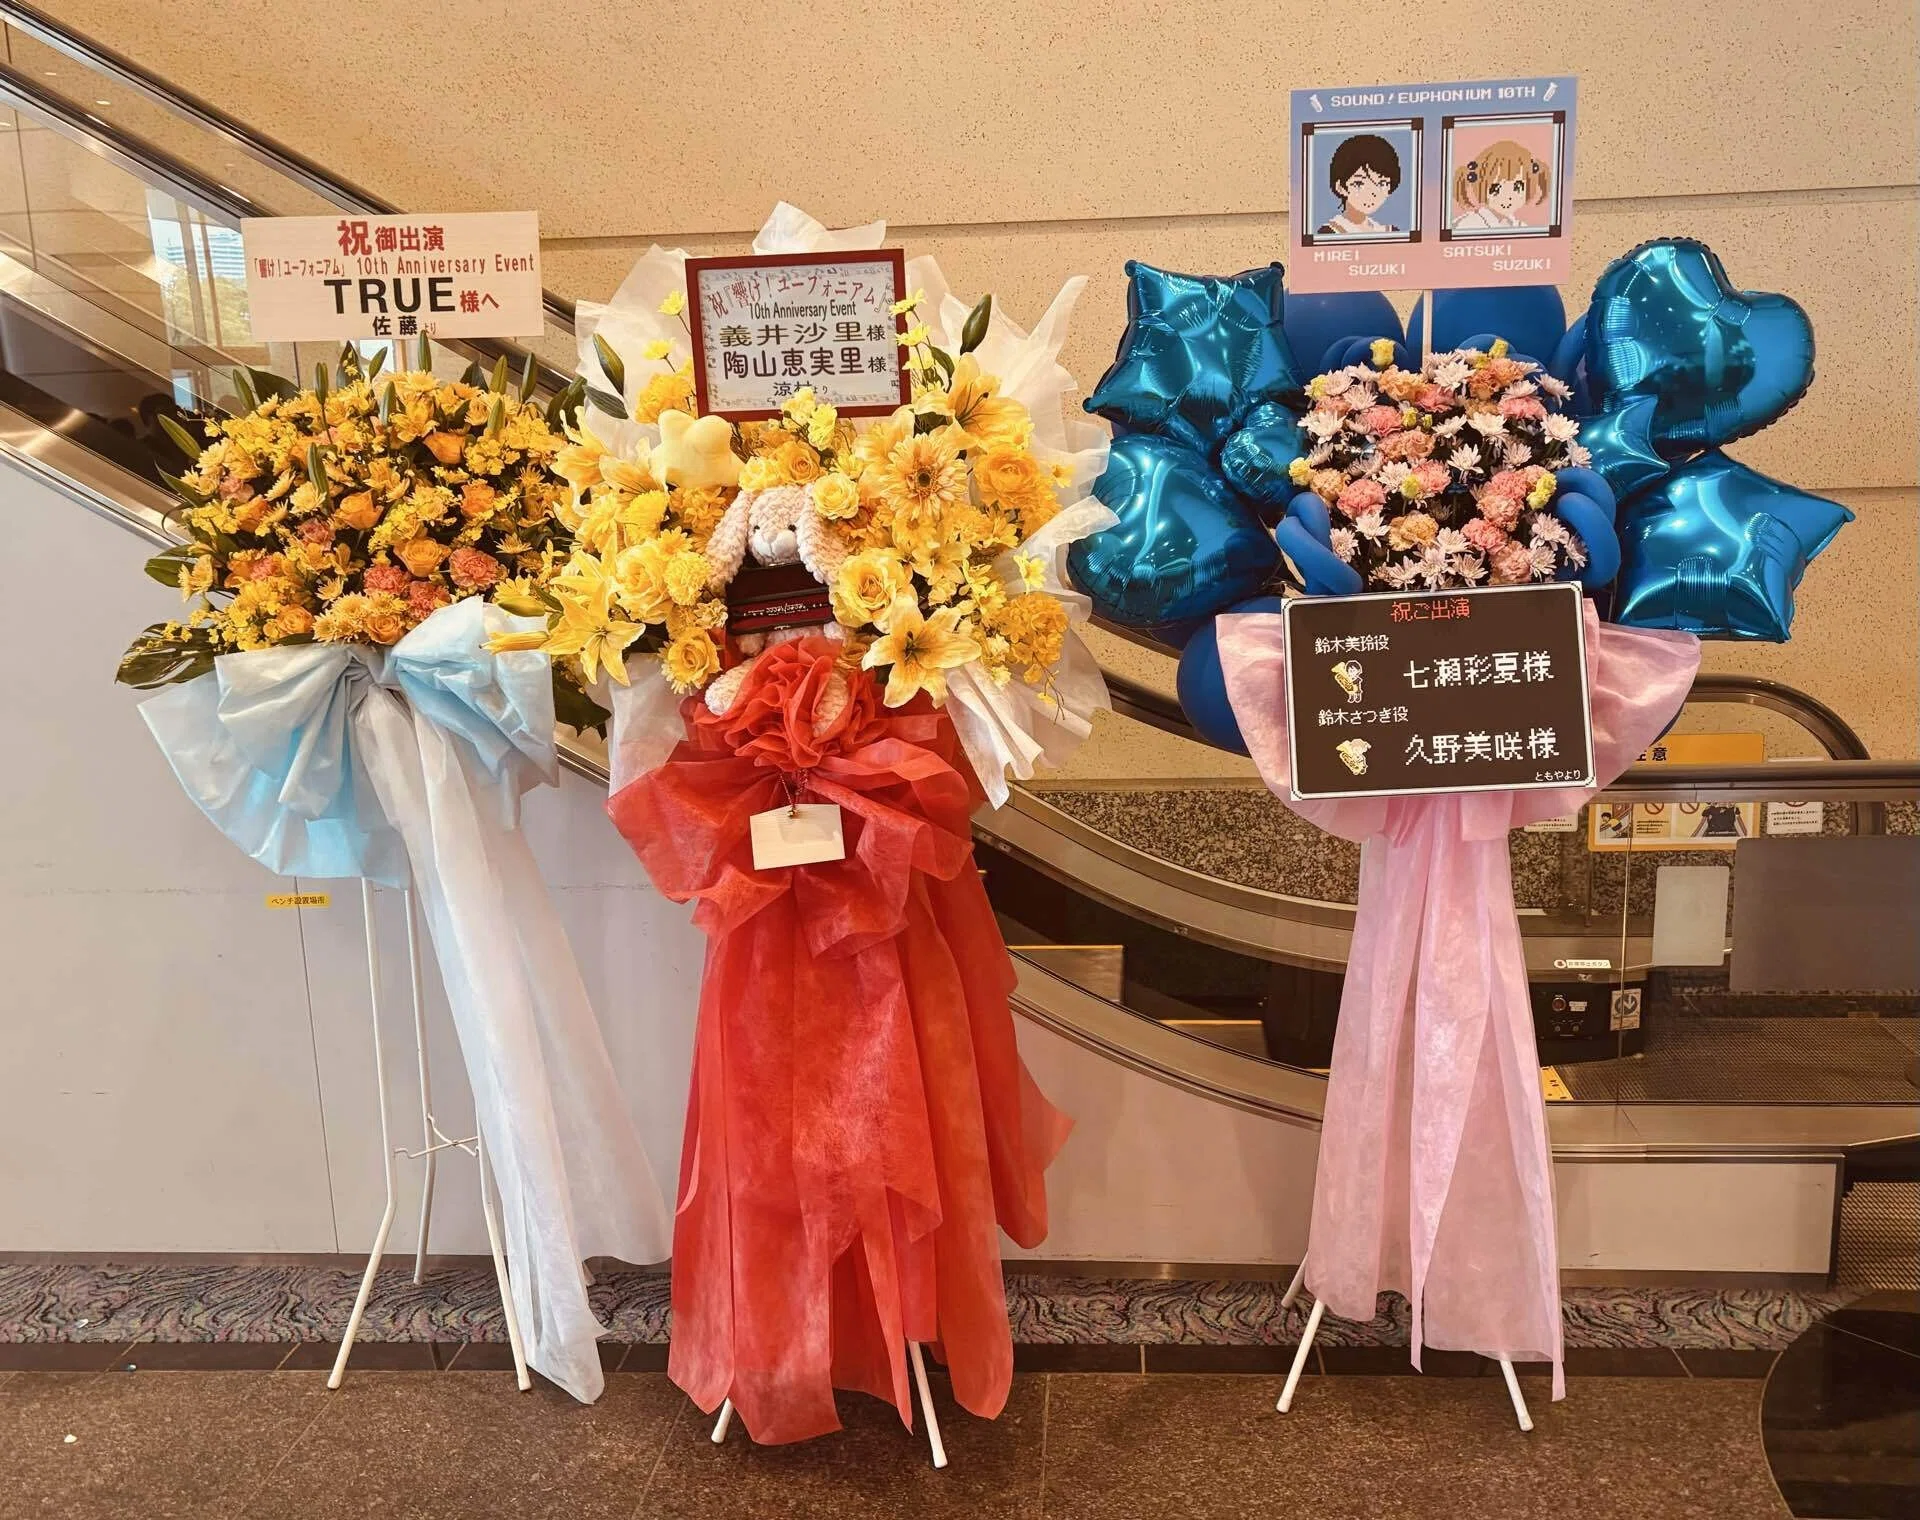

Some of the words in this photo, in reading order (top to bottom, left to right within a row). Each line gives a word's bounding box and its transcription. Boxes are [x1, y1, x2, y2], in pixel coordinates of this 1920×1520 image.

[1498, 86, 1535, 98] 10TH
[1313, 250, 1359, 262] MIREI
[1443, 246, 1512, 259] SATSUKI
[357, 257, 388, 275] 10th
[397, 254, 485, 274] Anniversary
[495, 254, 534, 272] Event
[1348, 263, 1405, 276] SUZUKI
[1492, 258, 1551, 272] SUZUKI
[750, 303, 771, 320] 10th
[773, 301, 828, 321] Anniversary
[830, 299, 857, 317] Event
[719, 321, 887, 347] 義井沙里様
[723, 347, 888, 379] 陶山恵実里様
[1390, 597, 1470, 622] 祝ご出演
[1314, 634, 1389, 655] 鈴木美玲役
[1403, 650, 1554, 689] 七瀬彩夏様
[1318, 706, 1409, 726] 鈴木さつき役
[1404, 727, 1559, 766] 久野美咲様
[1535, 769, 1581, 782] ともやより
